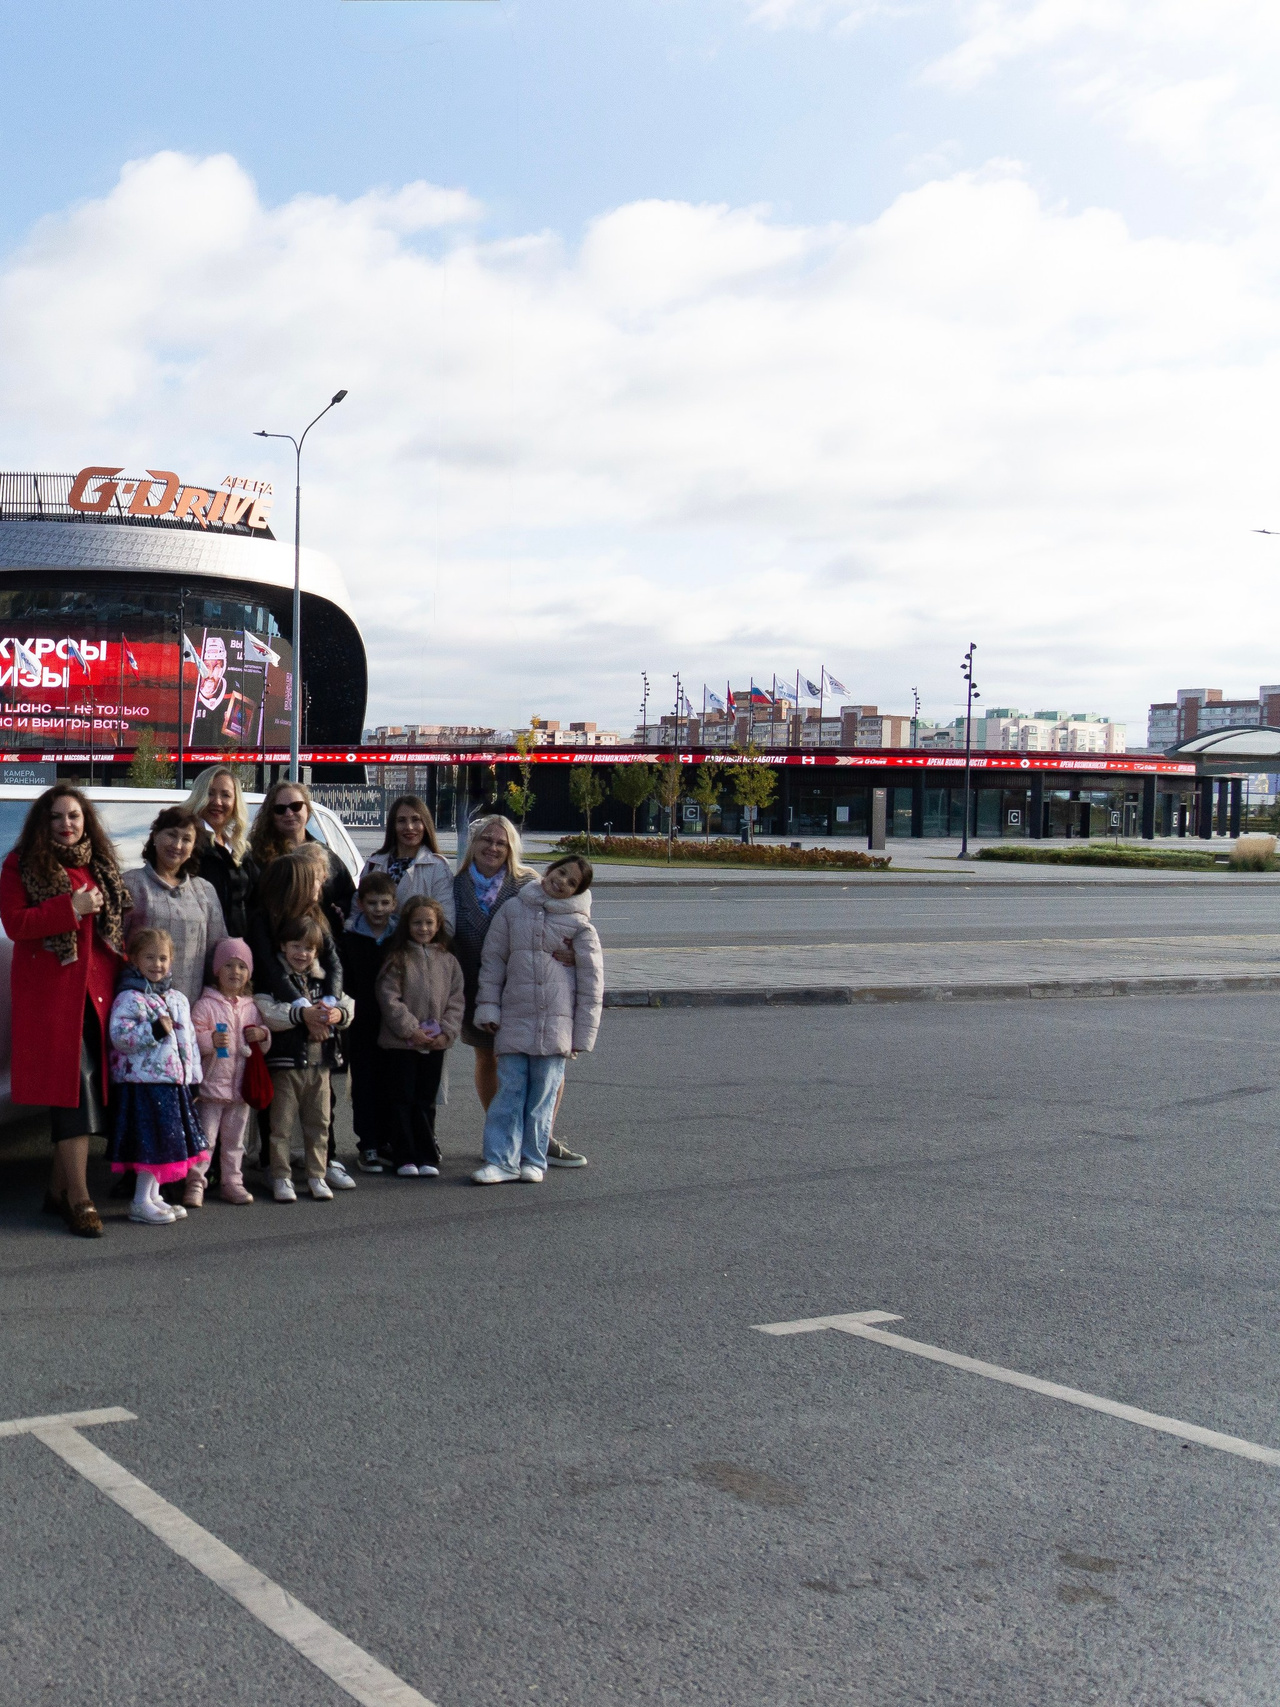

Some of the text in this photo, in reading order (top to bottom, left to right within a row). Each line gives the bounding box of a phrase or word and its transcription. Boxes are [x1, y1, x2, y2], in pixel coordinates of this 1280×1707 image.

[221, 475, 275, 495] АРЕНА
[5, 703, 52, 713] шанс
[74, 704, 93, 714] не
[17, 717, 28, 727] и
[573, 754, 593, 762] АРЕНА
[927, 758, 945, 766] АРЕНА
[4, 777, 45, 785] ХРАНЕНИЯ
